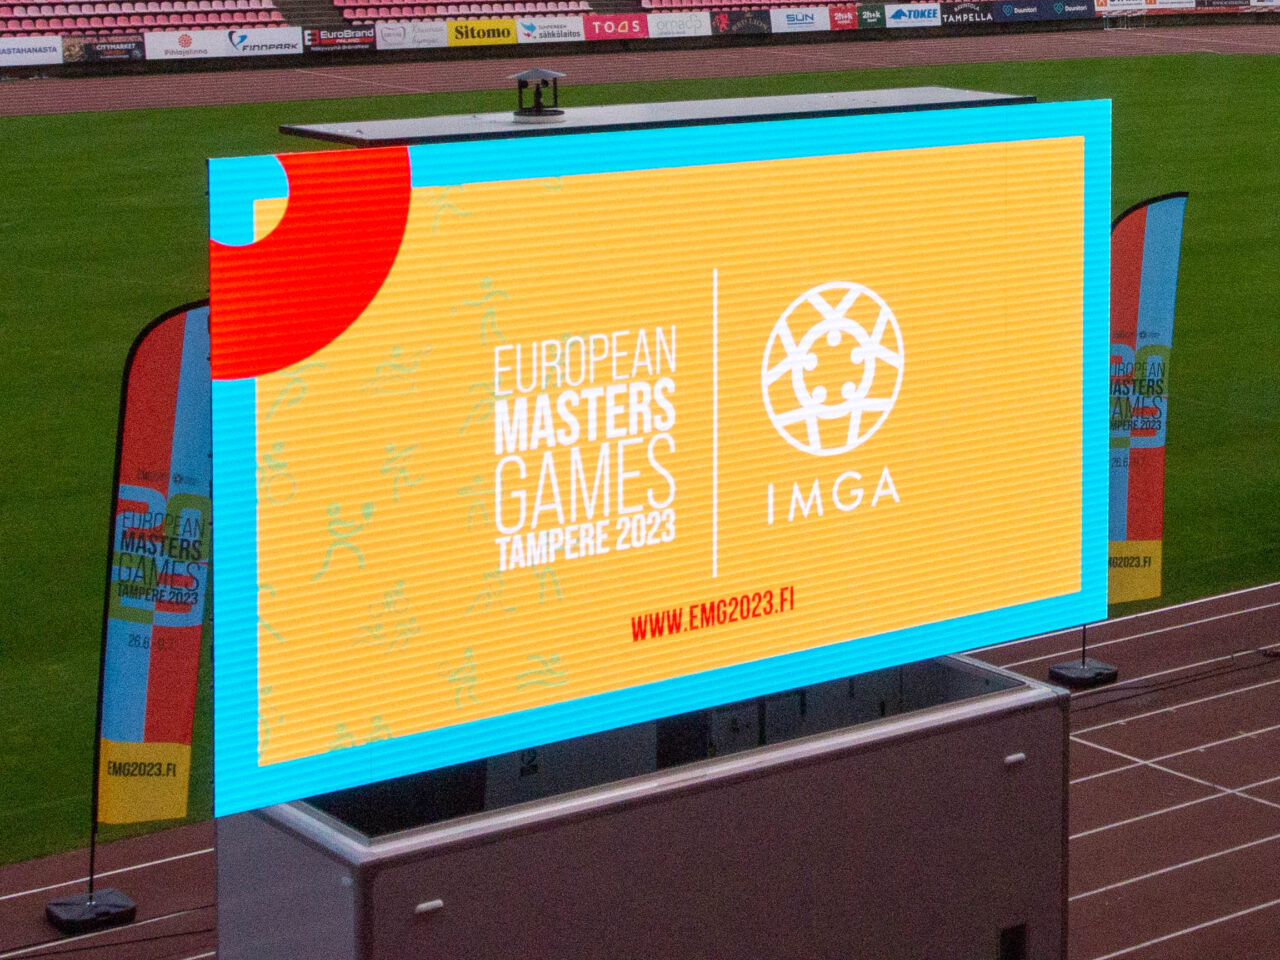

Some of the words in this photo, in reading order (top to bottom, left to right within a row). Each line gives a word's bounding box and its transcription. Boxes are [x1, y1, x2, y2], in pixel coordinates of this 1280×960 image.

[907, 8, 938, 19] TOKEE
[1013, 6, 1038, 14] Duunitori
[1064, 4, 1088, 12] Duunitori
[942, 13, 993, 23] TAMPELLA
[320, 29, 374, 40] EuroBrand
[454, 24, 511, 40] Sitomo
[538, 29, 582, 39] sähkölaitos
[0, 46, 58, 55] ASTAHANASTA
[164, 49, 208, 57] Pihlajalinna
[242, 43, 298, 52] FINNPARK
[494, 325, 677, 397] EUROPEAN
[1110, 361, 1166, 378] UROPEAN
[494, 377, 676, 455] MASTERS
[1111, 396, 1163, 420] AMES
[1110, 419, 1138, 431] MPERE
[494, 433, 676, 535] GAMES
[767, 465, 901, 526] IMGA
[121, 509, 206, 538] EUROPEAN
[120, 530, 202, 561] MASTERS
[494, 520, 610, 572] TAMPERE
[616, 508, 676, 552] 2023
[1109, 555, 1152, 568] G2023.FI
[117, 552, 201, 592] GAMES
[117, 583, 166, 602] TAMPERE
[168, 591, 199, 606] 2023
[630, 585, 796, 643] WWW.EMG2023.FI
[107, 760, 177, 778] EMG2023.FI
